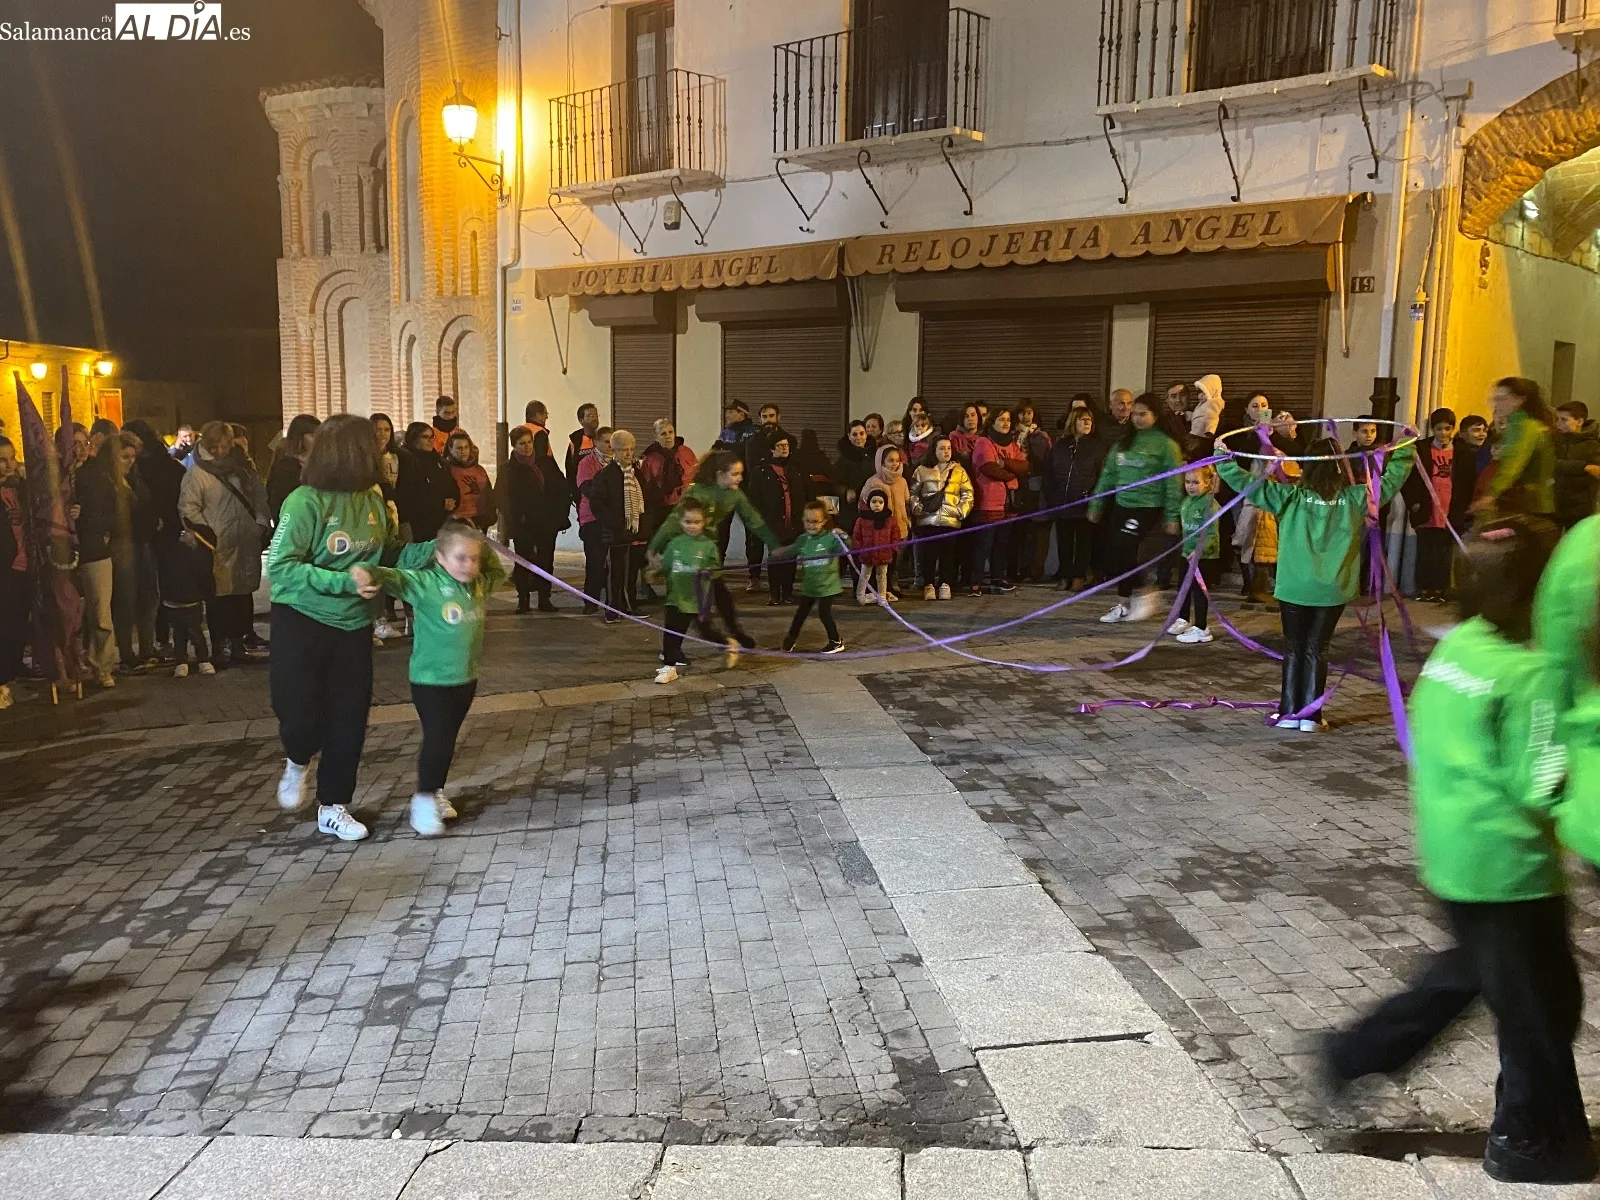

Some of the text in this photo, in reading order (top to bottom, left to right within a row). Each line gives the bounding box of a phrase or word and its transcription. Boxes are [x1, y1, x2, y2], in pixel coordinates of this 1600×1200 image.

[875, 210, 1283, 265] RELOJERIA ANGEL
[572, 255, 779, 288] JOYERIA ANGEL
[1353, 276, 1375, 292] 19
